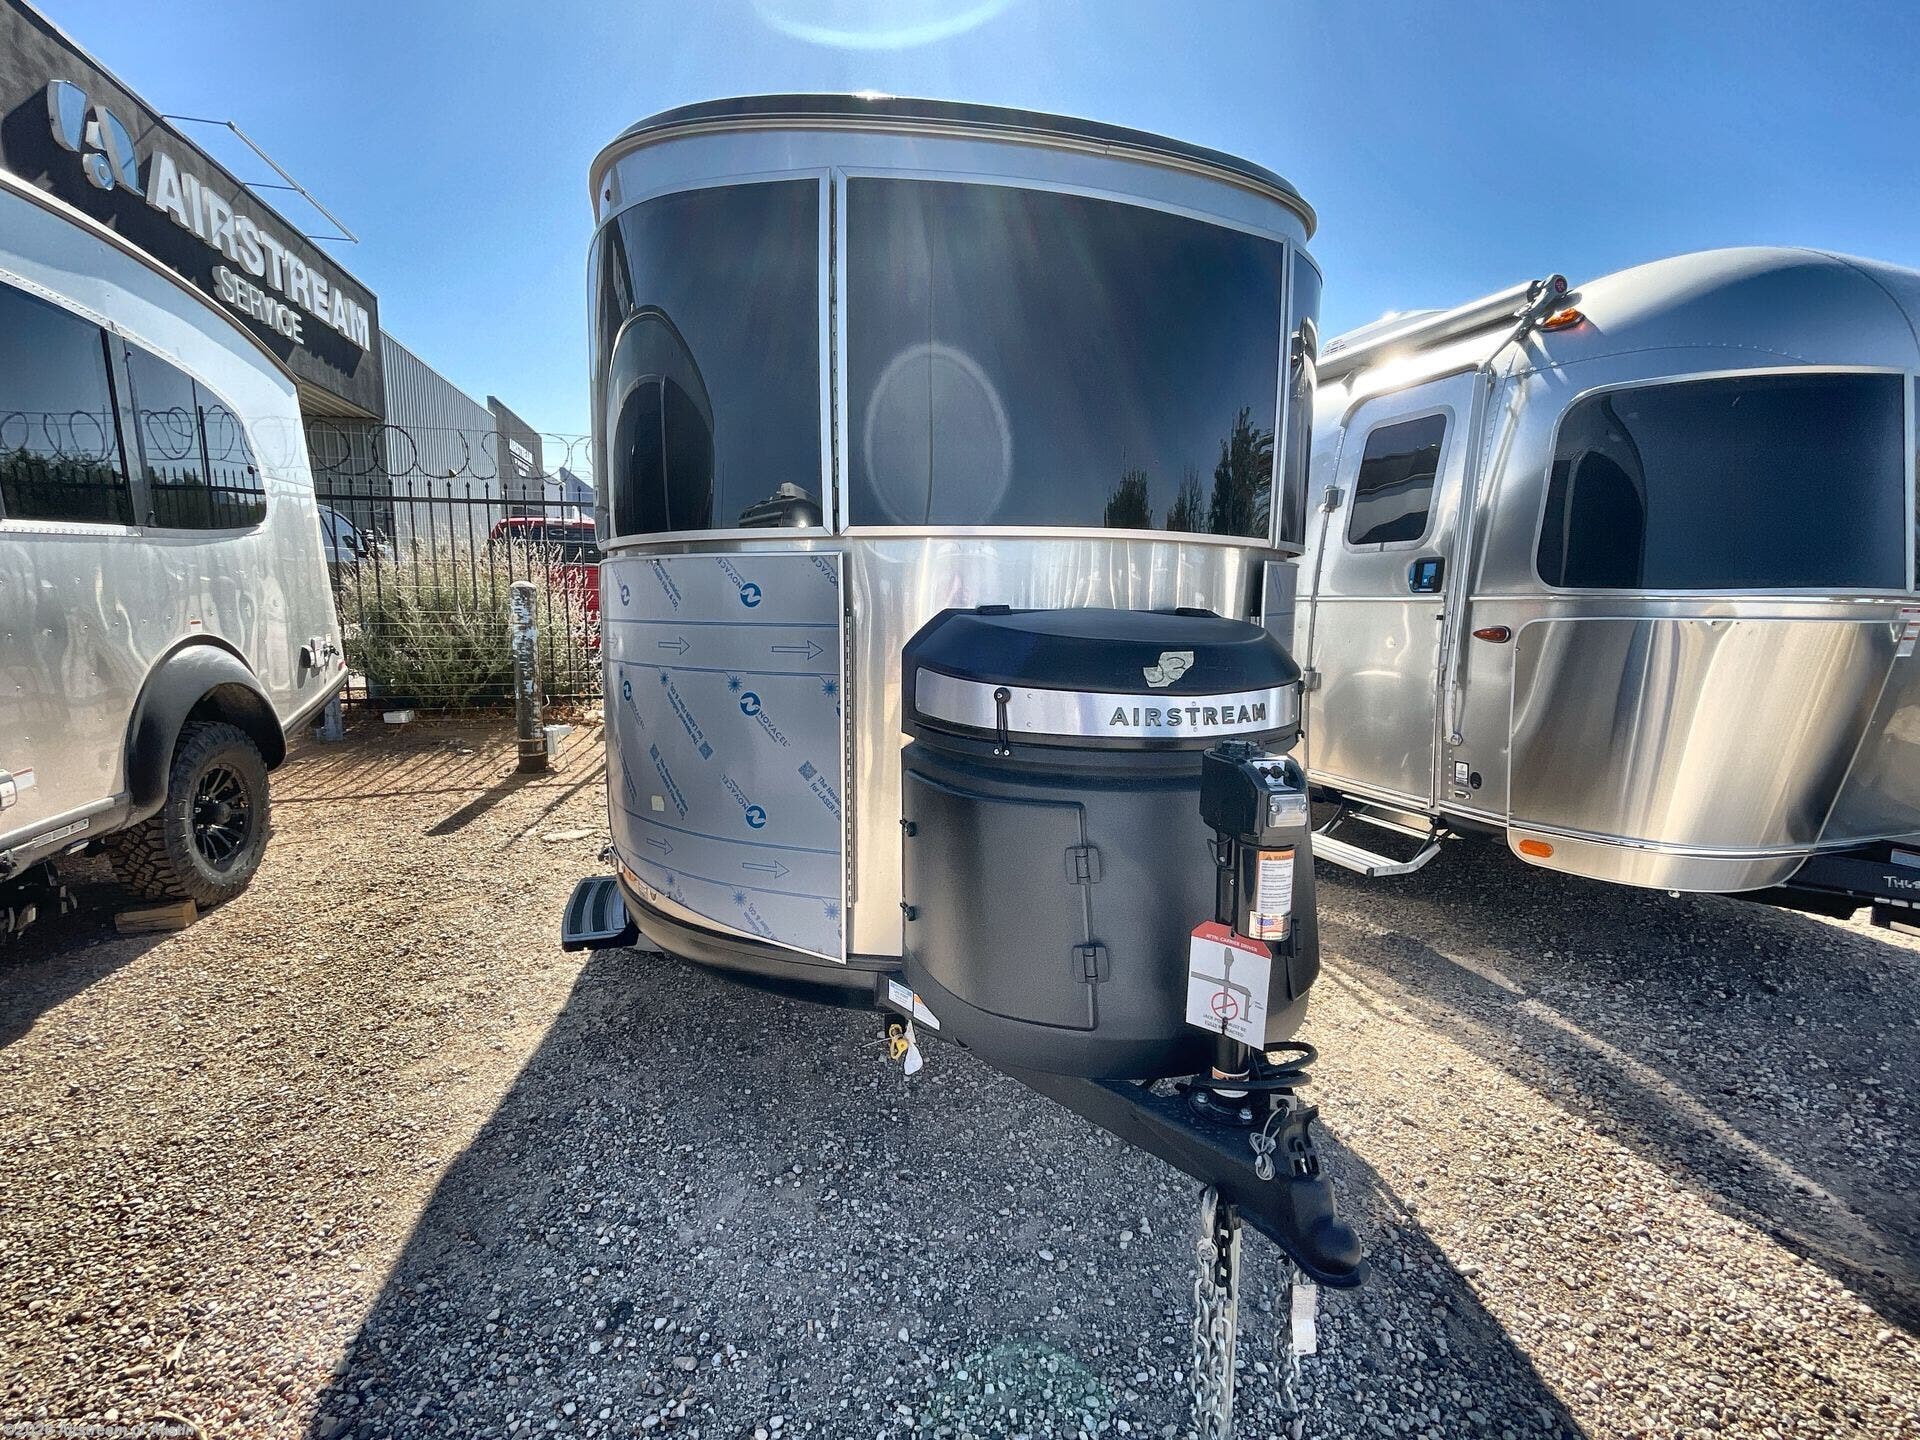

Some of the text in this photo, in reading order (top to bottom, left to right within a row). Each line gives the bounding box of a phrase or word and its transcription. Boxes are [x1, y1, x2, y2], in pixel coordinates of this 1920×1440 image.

[149, 151, 371, 352] AIRSTREAM
[213, 265, 305, 345] SERVICE
[756, 710, 790, 747] NOVACEL
[1109, 702, 1267, 727] AIRSTREAM
[718, 774, 750, 810] NOVACEL
[810, 782, 820, 793] for
[817, 791, 836, 811] LASER
[817, 775, 841, 806] The Nova
